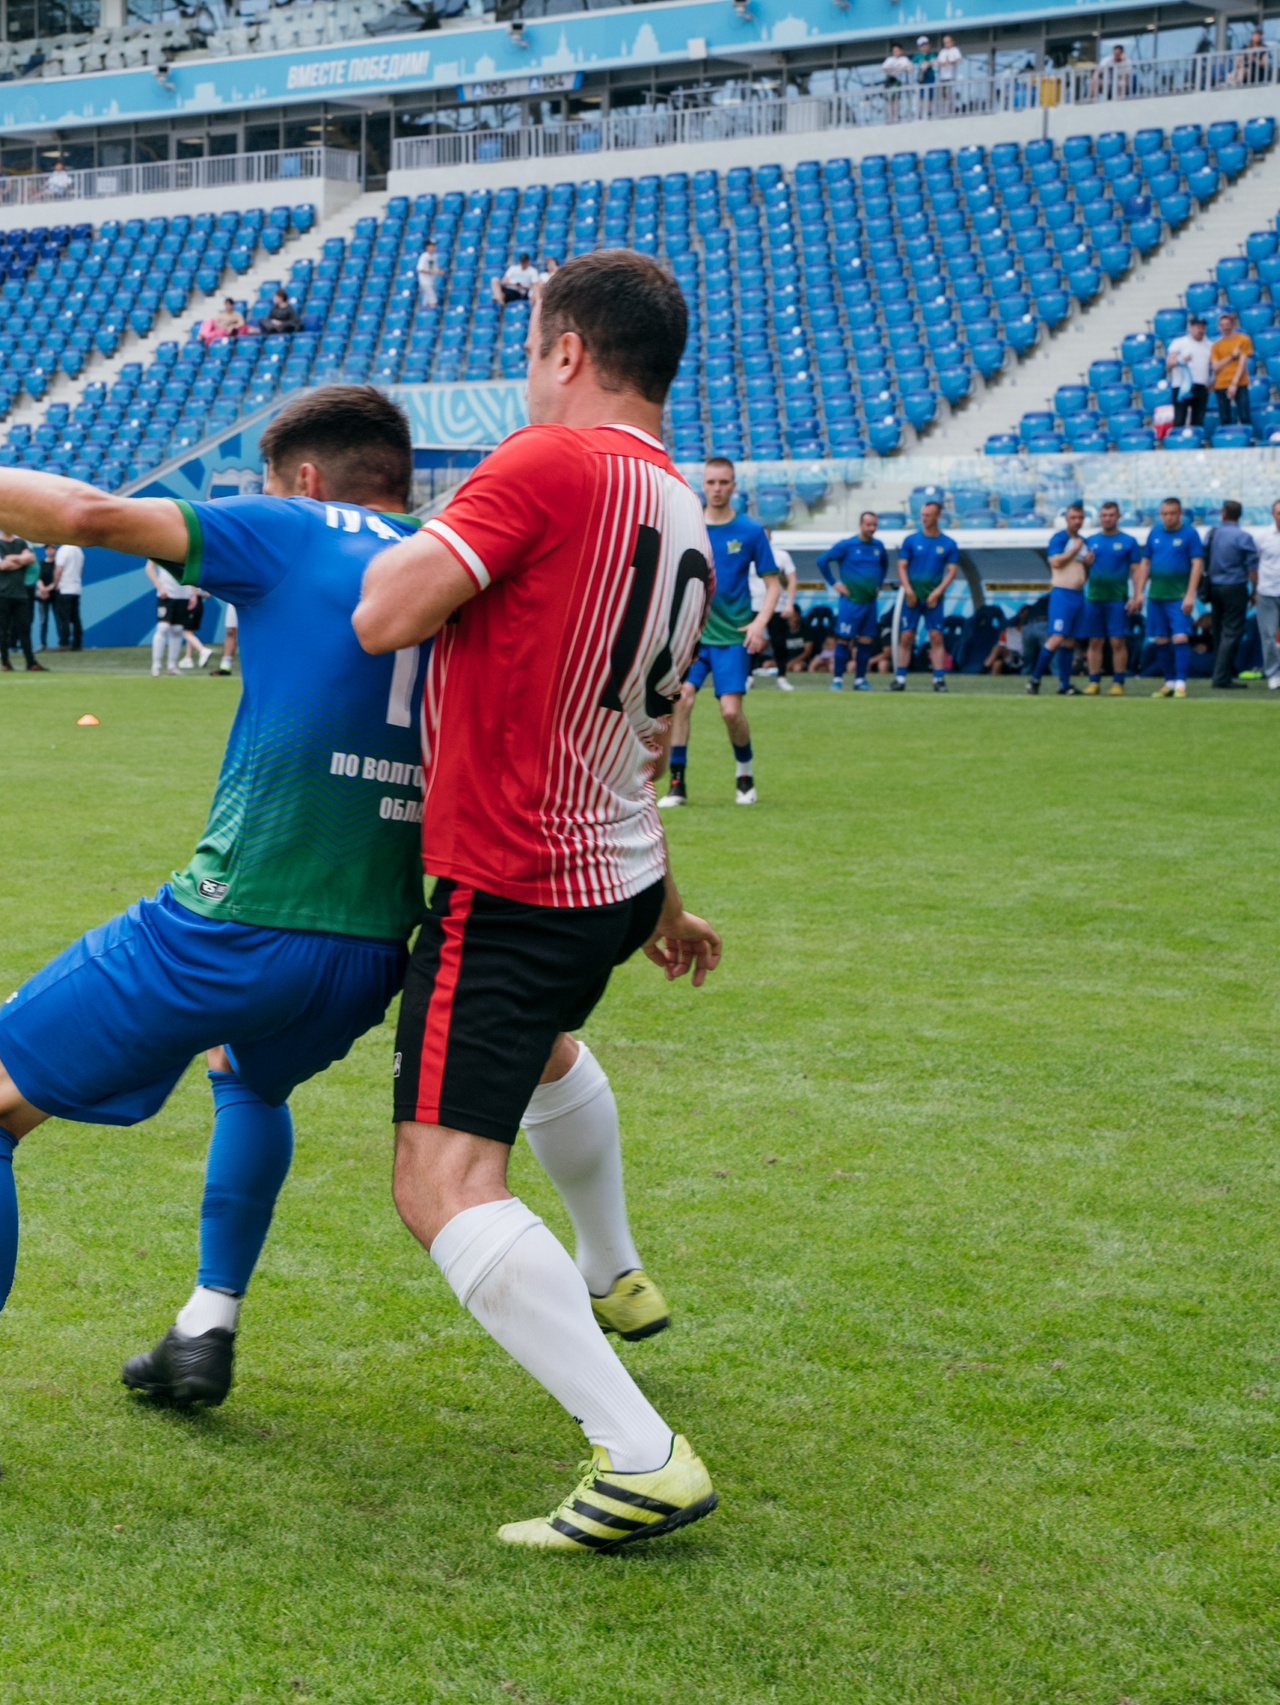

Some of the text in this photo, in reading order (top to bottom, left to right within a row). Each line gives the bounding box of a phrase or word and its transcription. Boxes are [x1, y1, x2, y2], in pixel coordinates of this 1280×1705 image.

[286, 50, 431, 89] ВМЕСТЕ ПОБЕДИМ!
[485, 80, 508, 95] 105
[542, 76, 565, 90] 104
[329, 751, 360, 778] ПО
